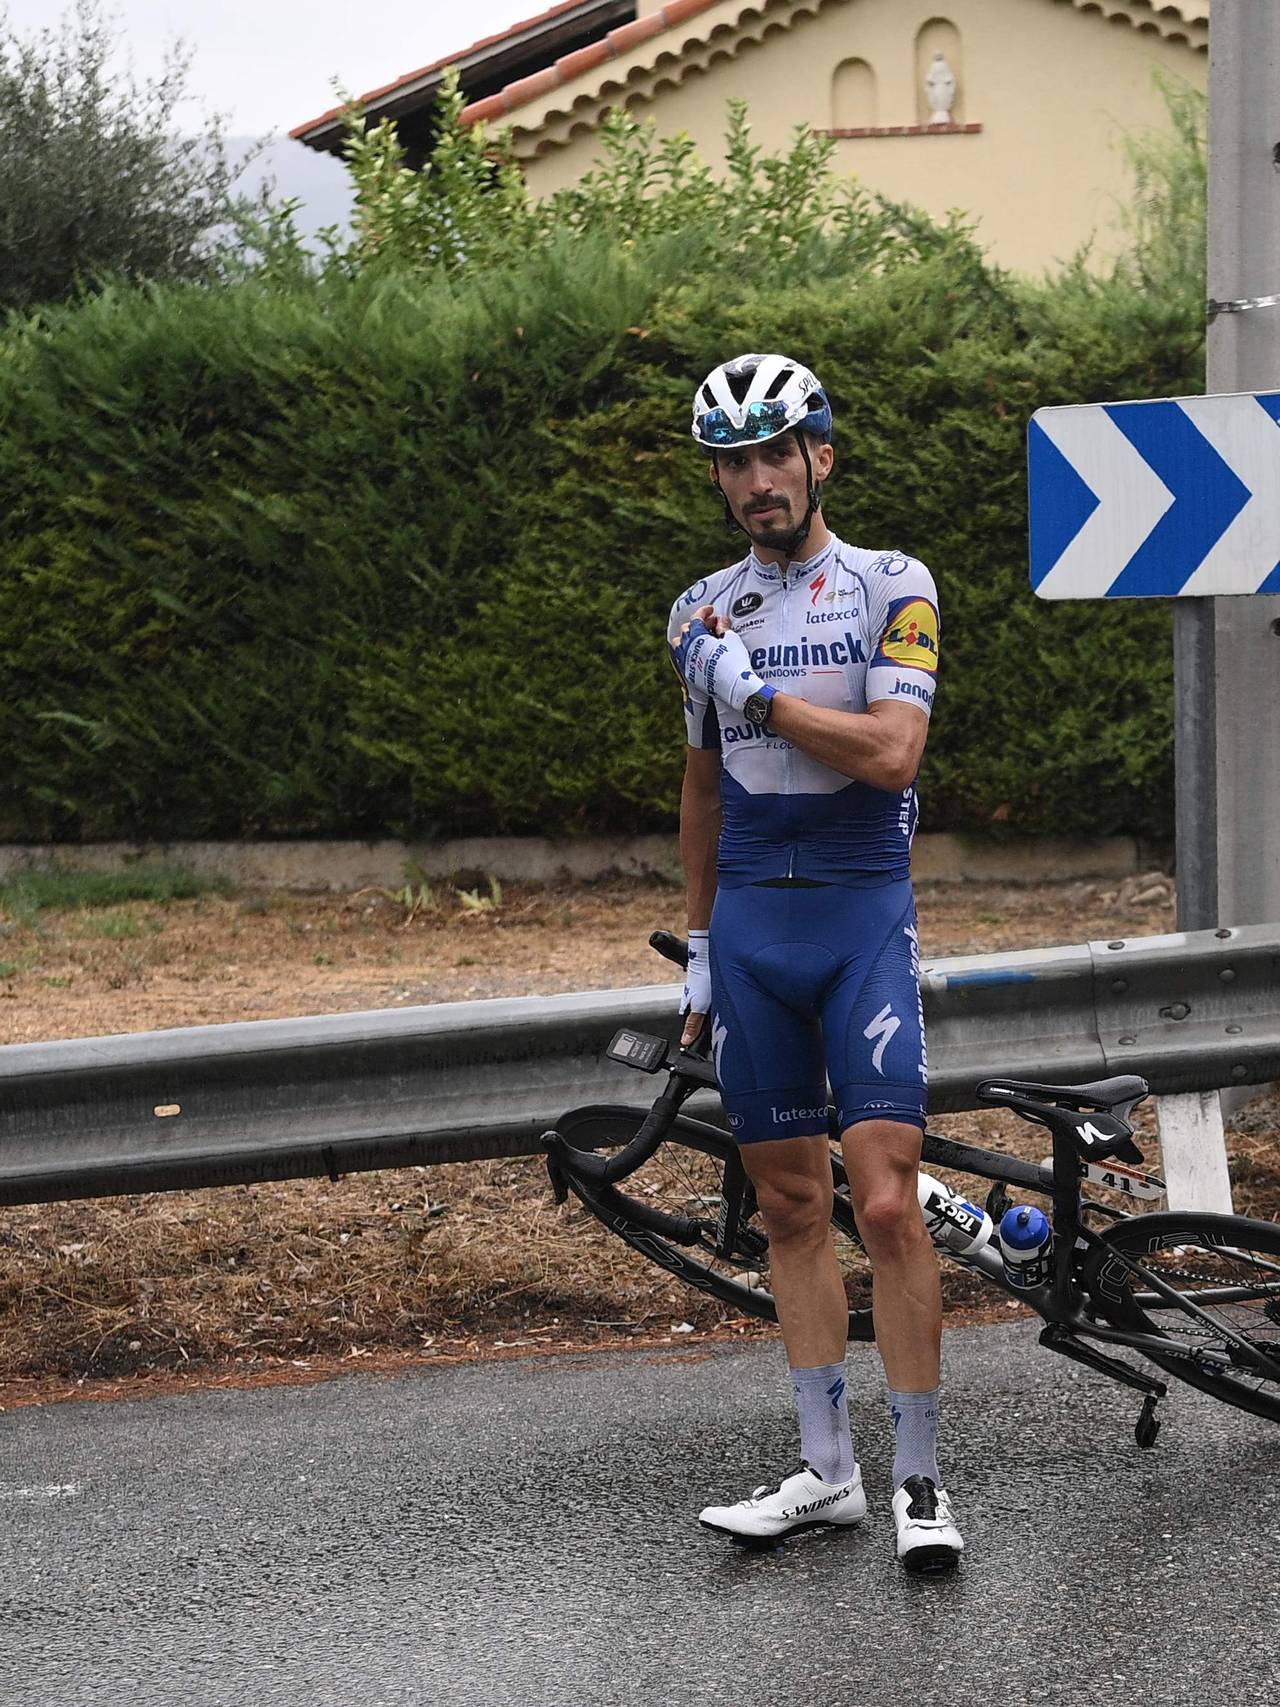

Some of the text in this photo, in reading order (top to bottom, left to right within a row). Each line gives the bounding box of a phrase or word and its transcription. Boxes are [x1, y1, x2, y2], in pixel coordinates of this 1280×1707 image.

[806, 607, 860, 625] latexco
[756, 668, 807, 680] WINDOWS
[724, 723, 779, 743] QUIC
[770, 1106, 829, 1124] latexco
[1101, 1172, 1133, 1193] 41
[935, 1197, 977, 1232] Tacx
[780, 1484, 850, 1521] S-WORKS
